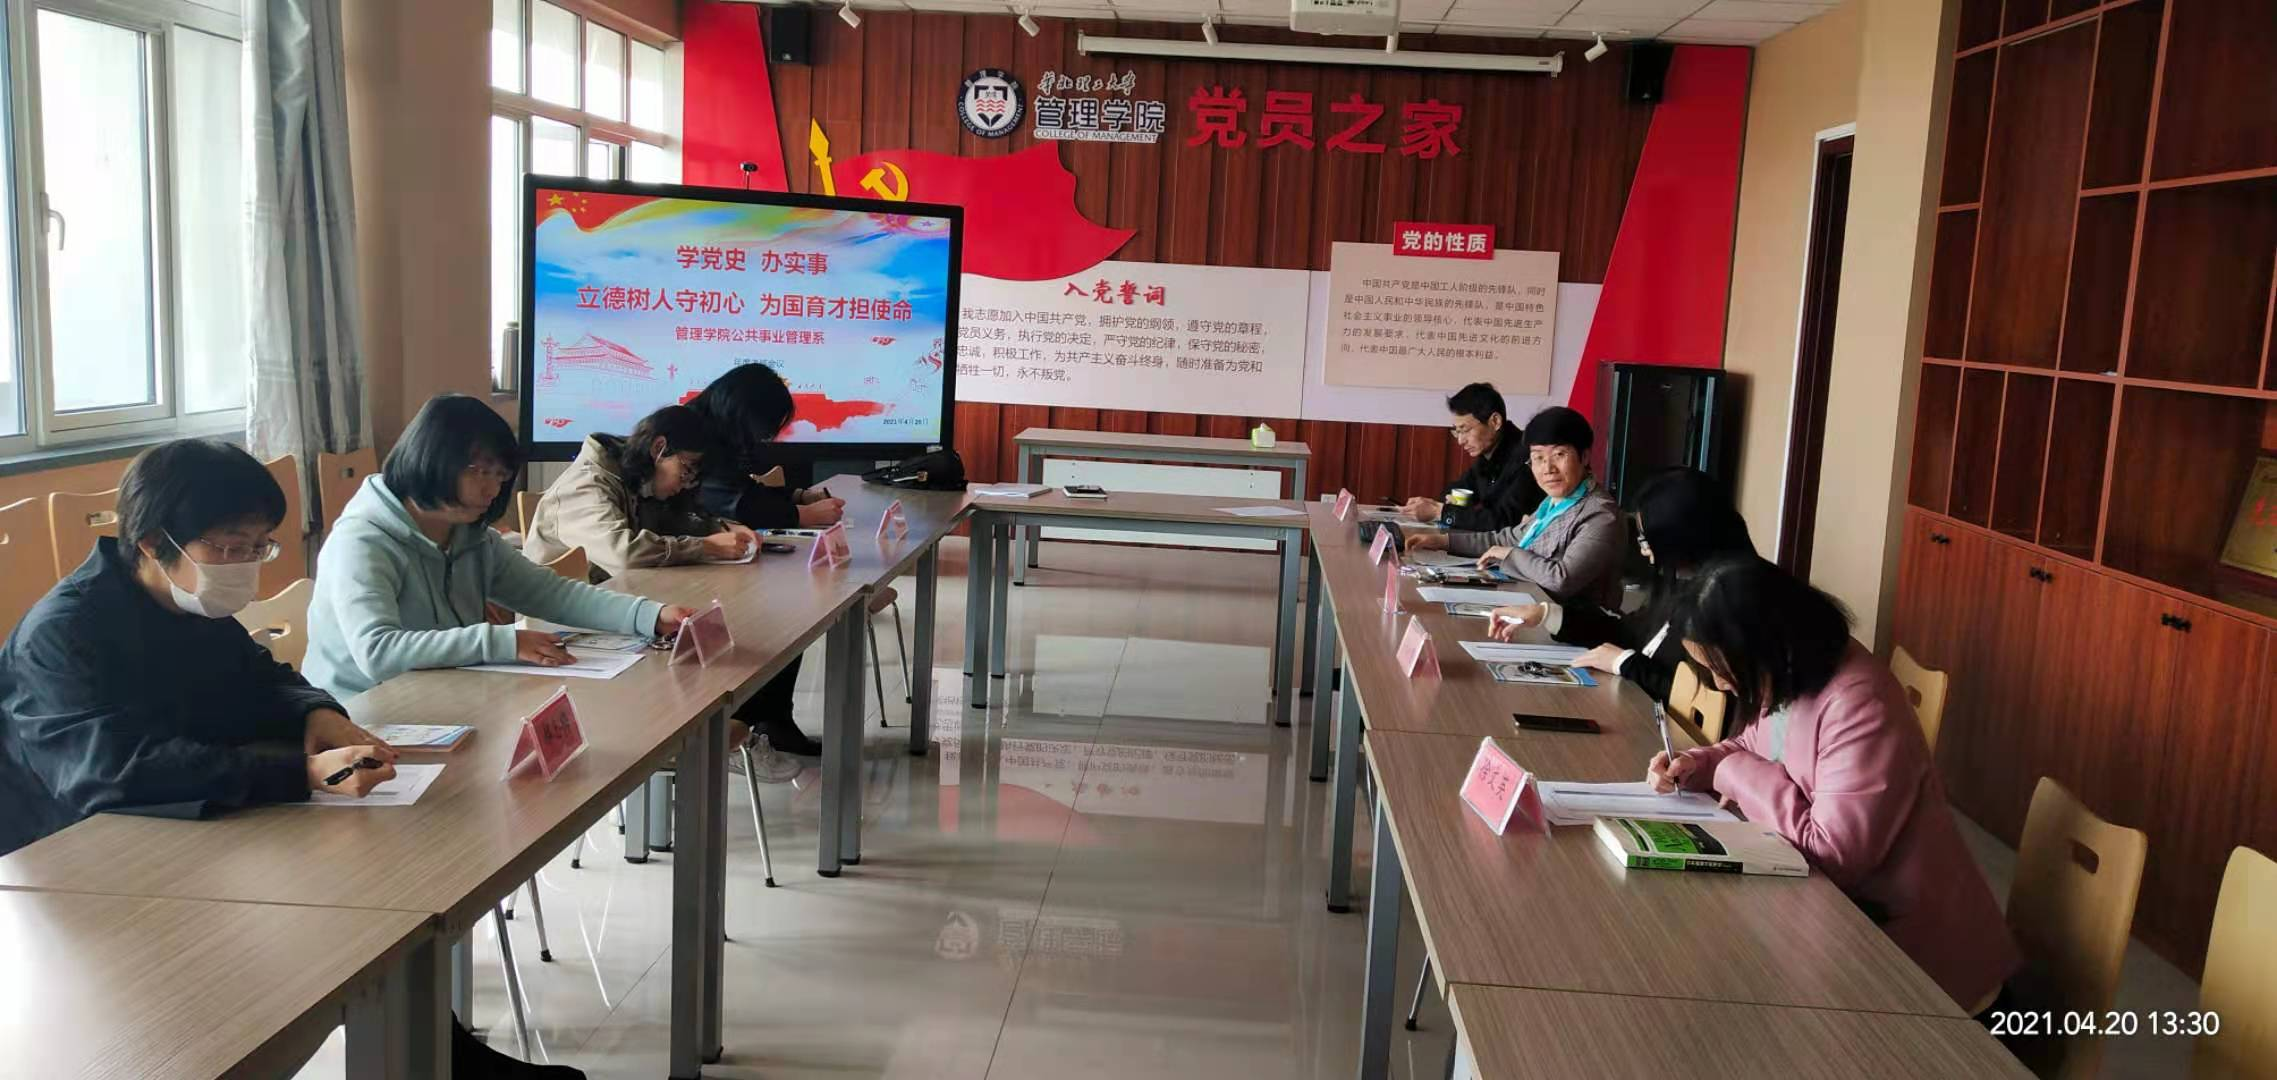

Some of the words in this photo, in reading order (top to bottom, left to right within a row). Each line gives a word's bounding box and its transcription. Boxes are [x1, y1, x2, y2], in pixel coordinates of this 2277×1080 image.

[1035, 97, 1165, 132] 管理学院
[1188, 85, 1464, 159] 党员之家
[1035, 129, 1075, 139] COLLEGE
[1078, 131, 1090, 140] OF
[1092, 131, 1157, 142] MANAGEMENT
[1402, 230, 1488, 254] 党的性质
[676, 245, 747, 273] 学党史
[760, 250, 829, 276] 办实事
[575, 285, 745, 315] 立德树人守初心
[759, 293, 913, 322] 为国育才担使命
[1064, 279, 1167, 307] 入党誓词
[675, 326, 825, 345] 管理学院公共事业管理系
